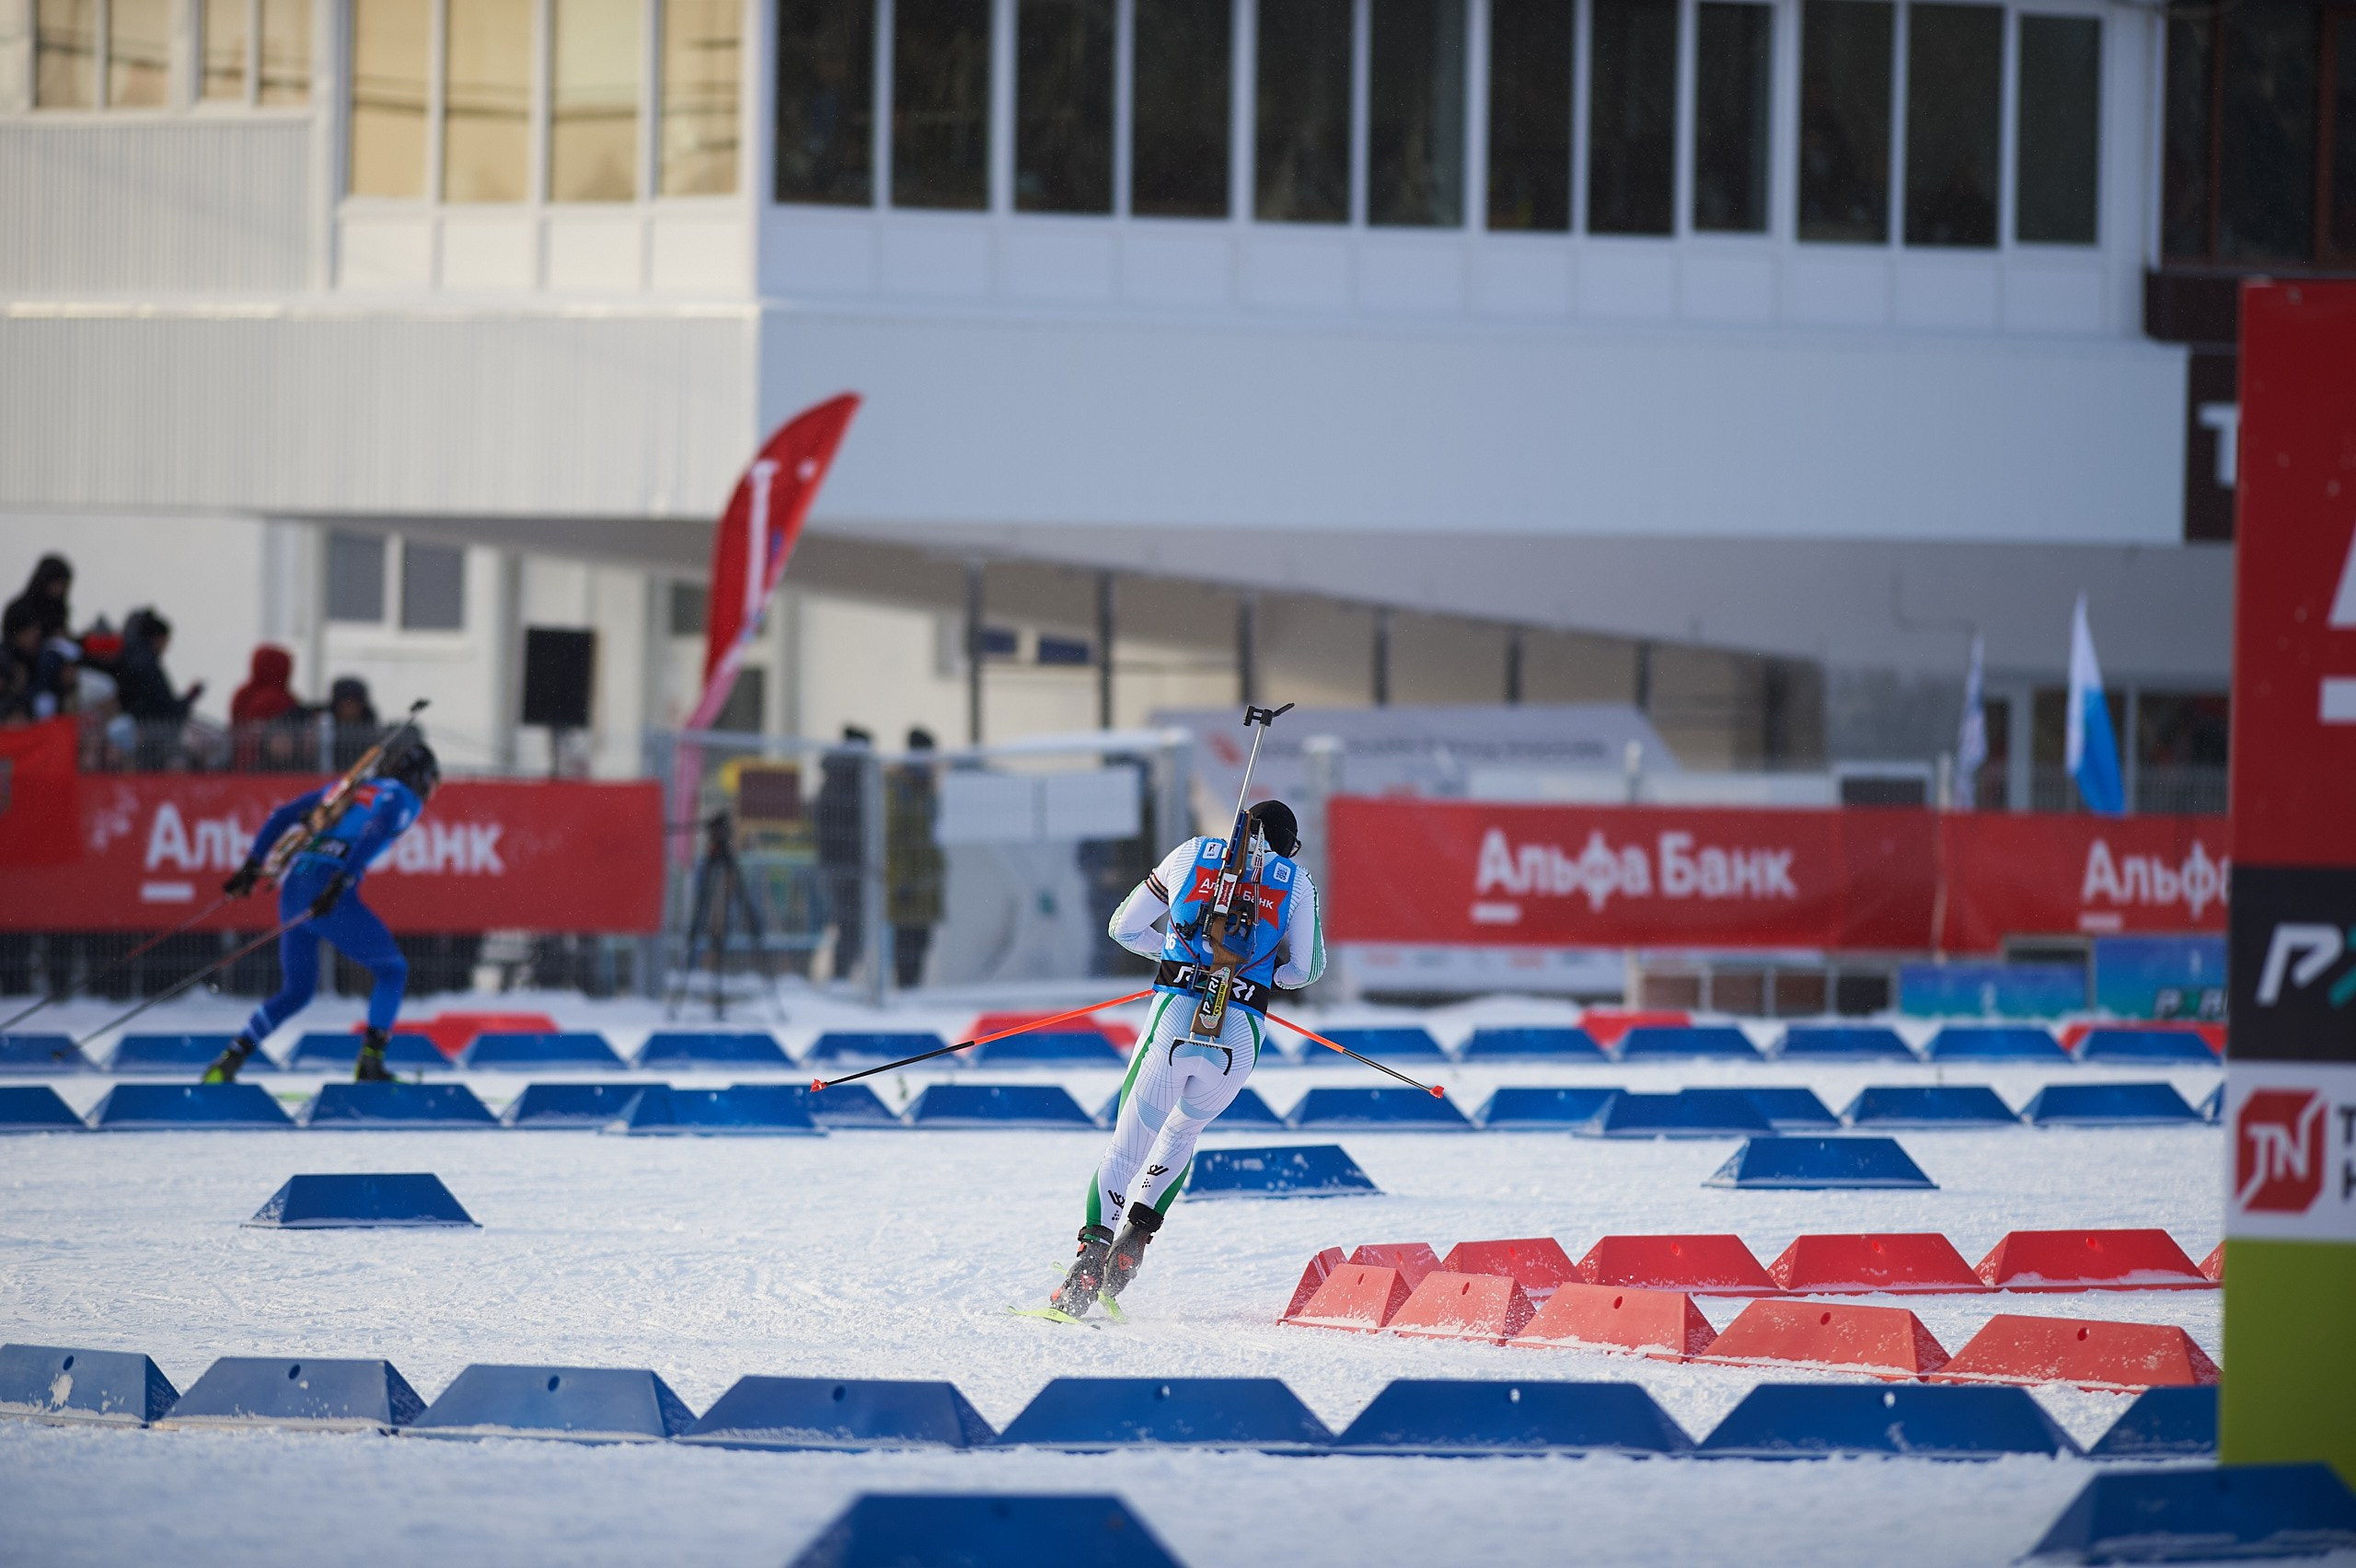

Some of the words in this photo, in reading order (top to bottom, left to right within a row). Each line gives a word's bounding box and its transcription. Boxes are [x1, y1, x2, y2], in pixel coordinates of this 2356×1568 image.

[145, 802, 255, 870] Аль
[370, 819, 504, 874] анк
[1476, 826, 1652, 910] Альфа
[1659, 831, 1796, 897] Банк
[1201, 976, 1219, 1014] PARI
